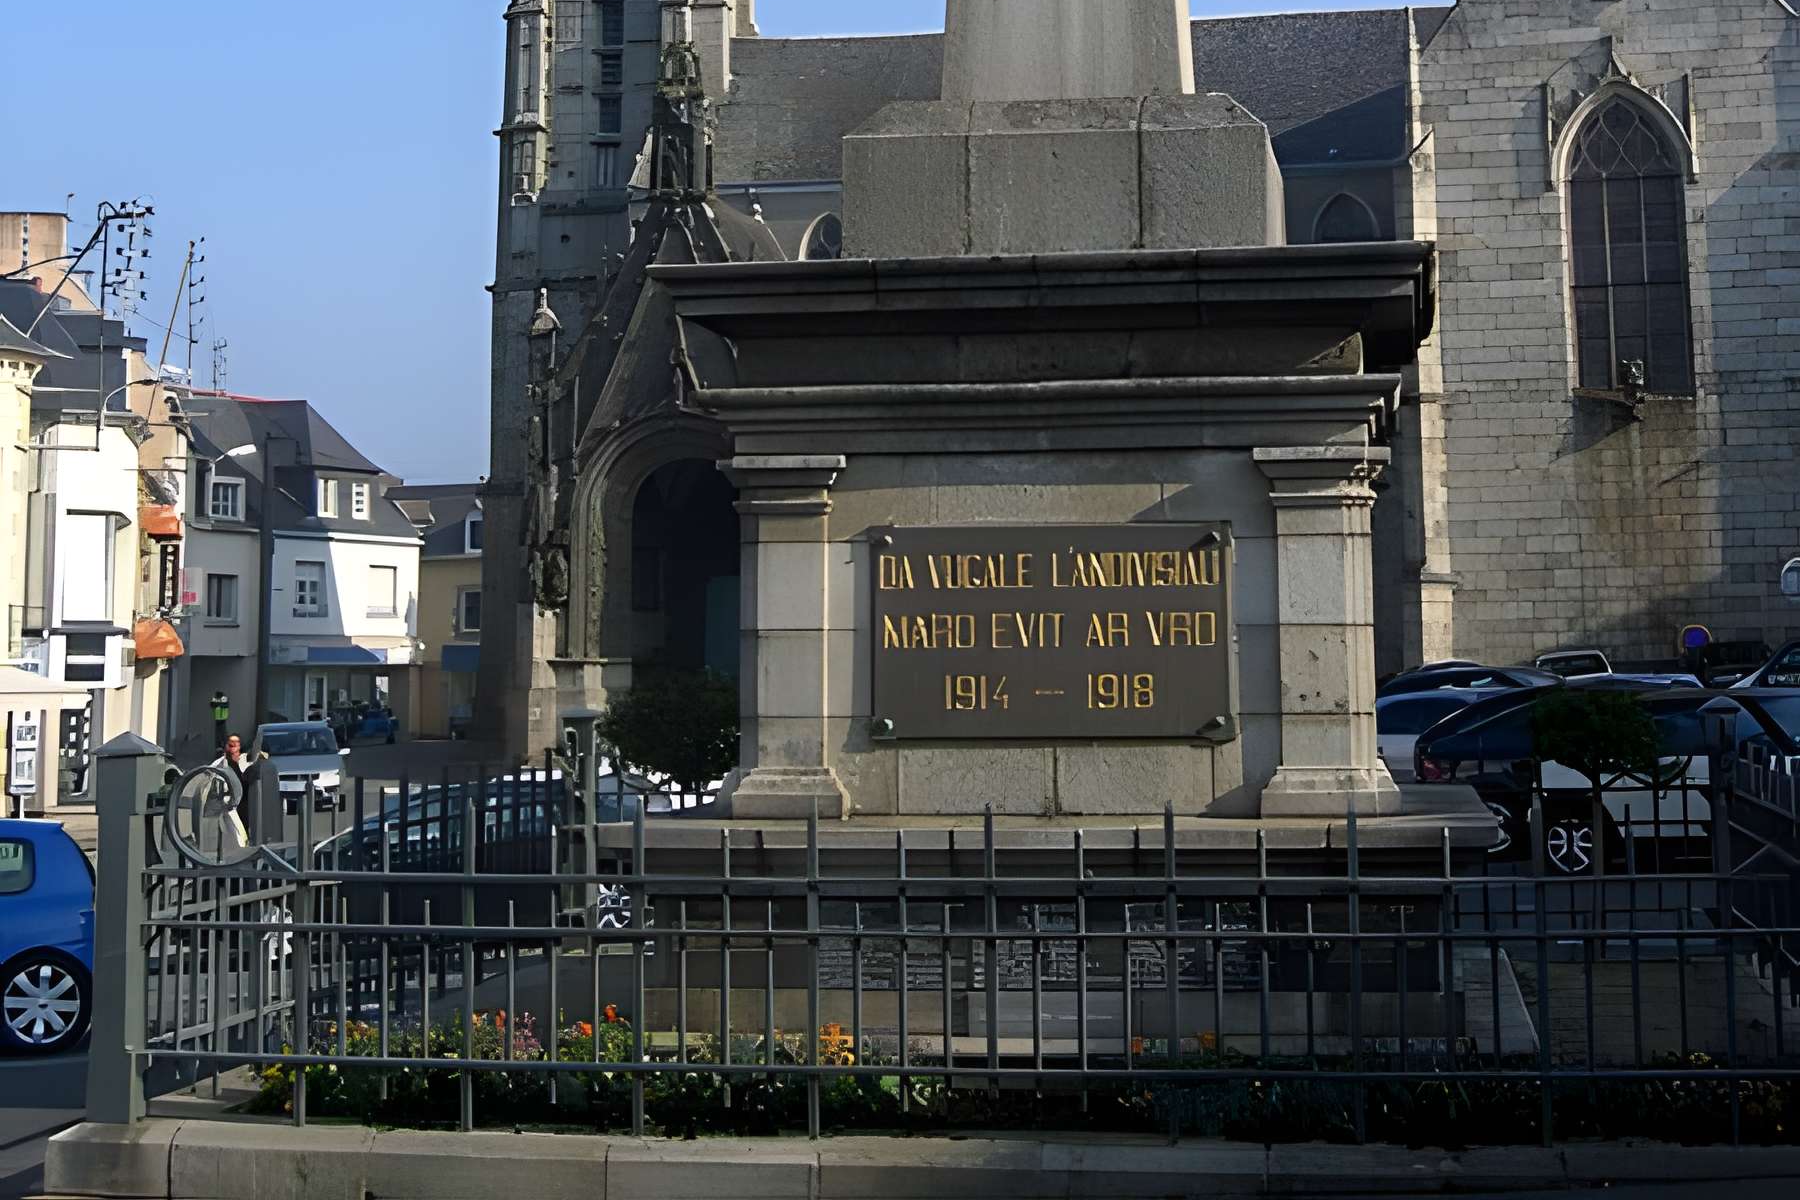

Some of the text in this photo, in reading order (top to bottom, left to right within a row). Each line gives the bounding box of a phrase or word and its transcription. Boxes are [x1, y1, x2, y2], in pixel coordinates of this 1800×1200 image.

[879, 553, 915, 590] DA
[991, 611, 1065, 649] EVIT
[1085, 612, 1130, 648] AR
[1145, 610, 1217, 647] VRO
[945, 674, 1009, 710] 1914
[1087, 673, 1154, 709] 1918
